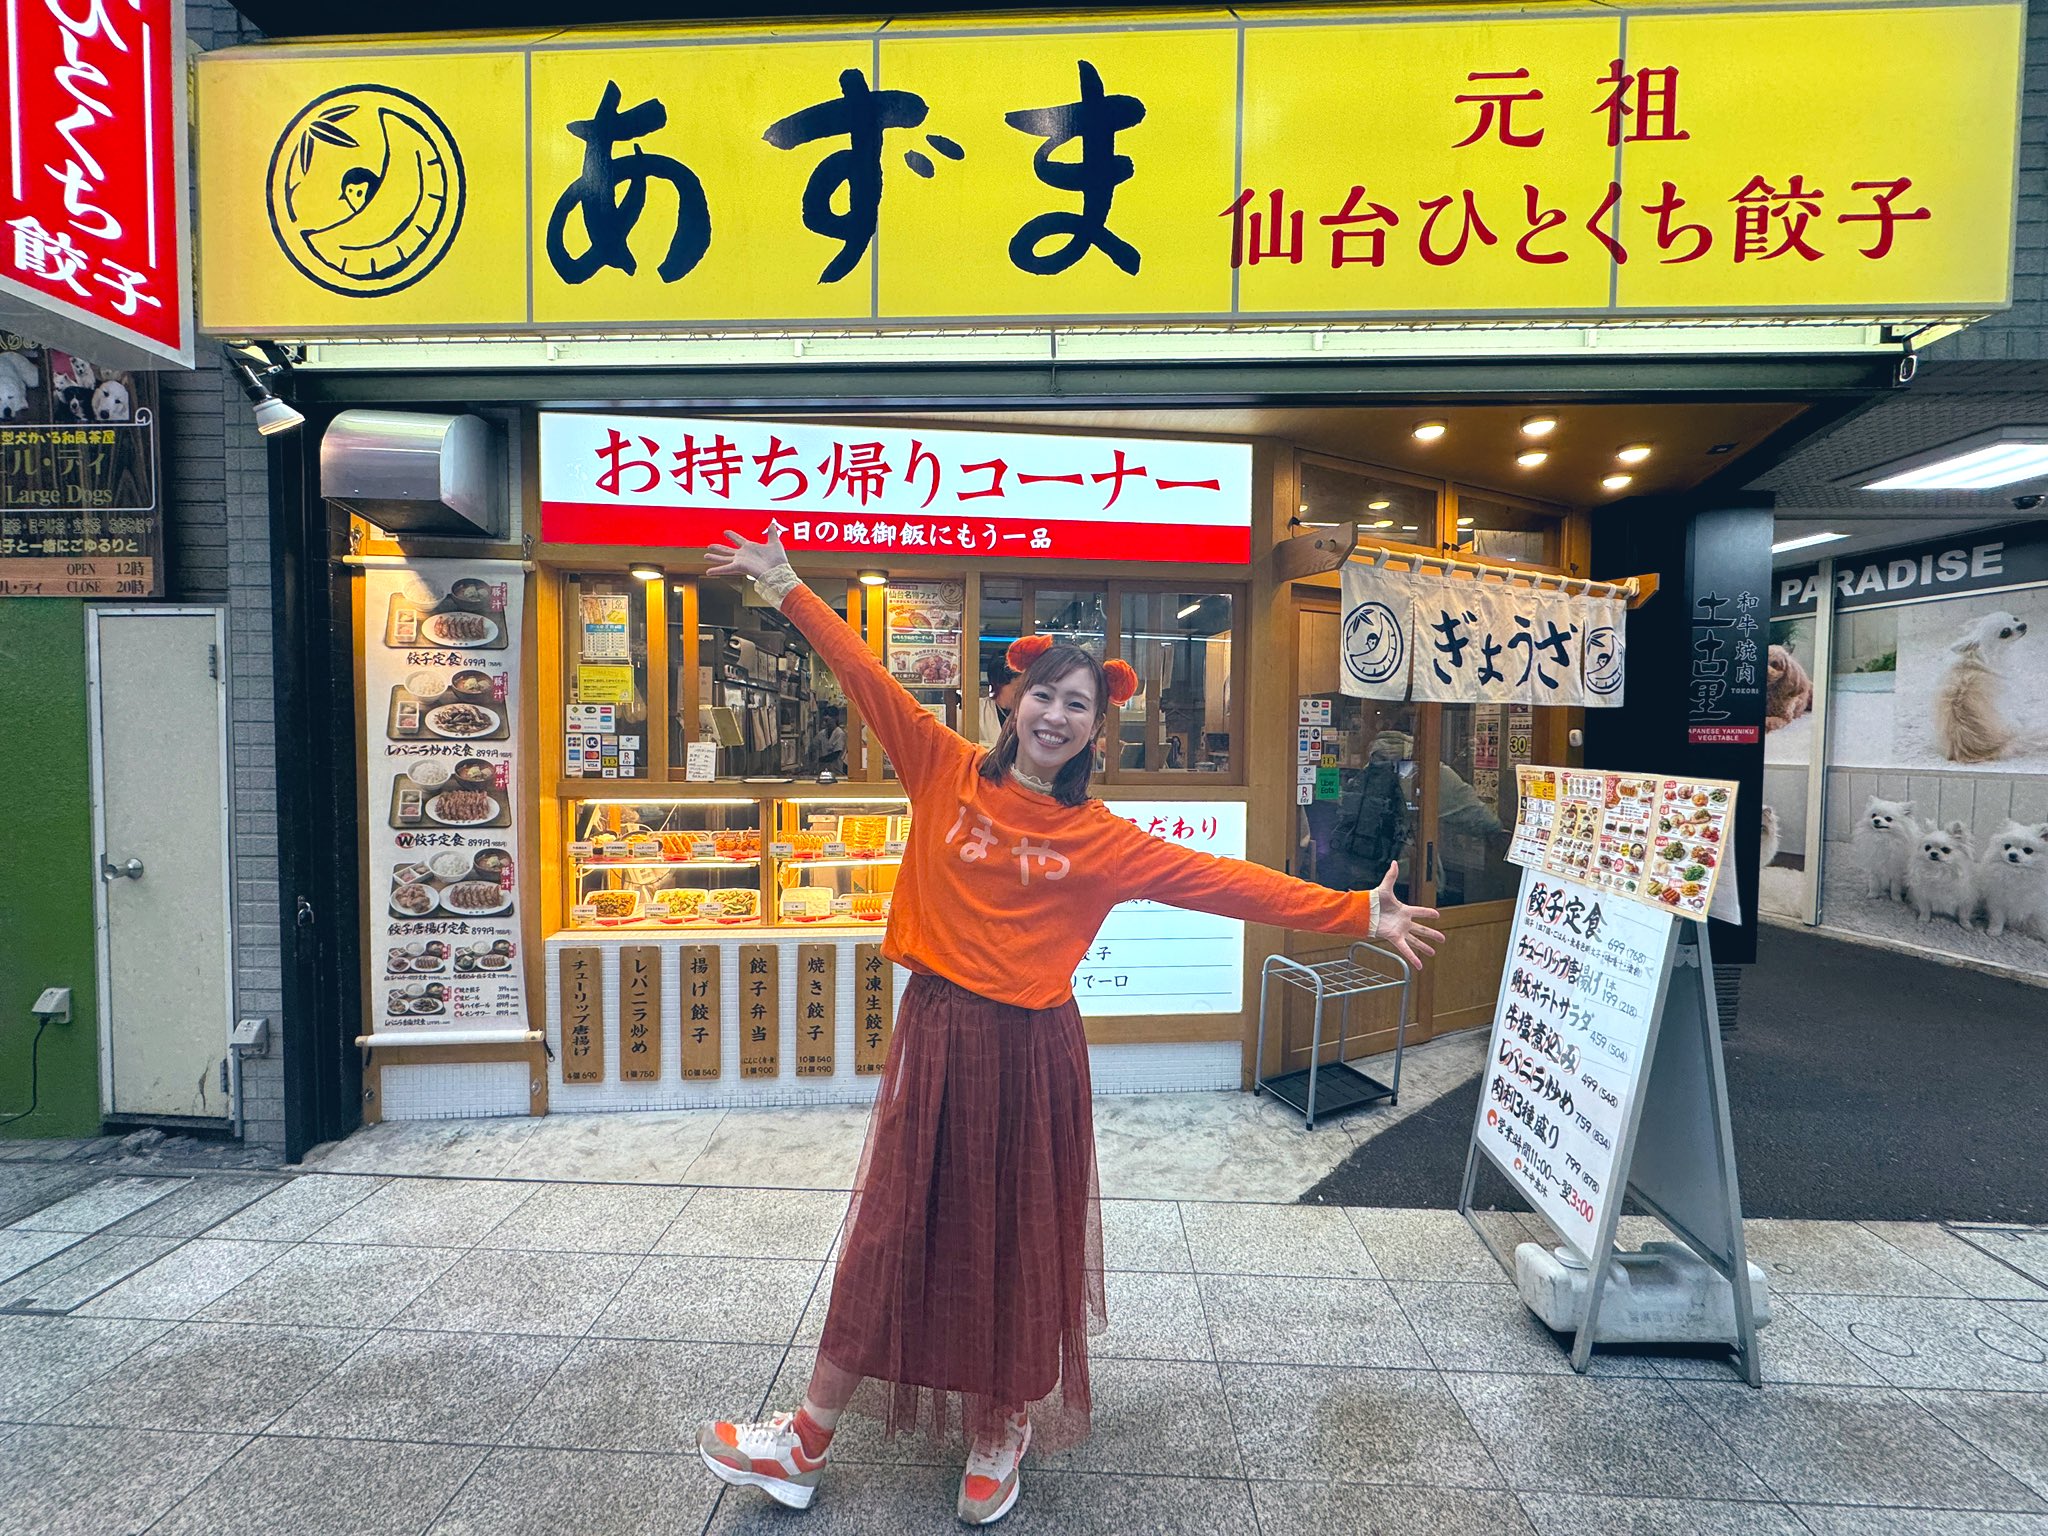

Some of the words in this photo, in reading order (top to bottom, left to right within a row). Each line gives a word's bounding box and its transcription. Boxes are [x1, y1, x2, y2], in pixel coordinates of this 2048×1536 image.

[44, 0, 129, 240] ひとくち
[1452, 59, 1691, 149] 元祖
[546, 60, 1147, 286] あずま
[1218, 175, 1932, 269] 仙台ひとくち餃子
[5, 215, 162, 317] 餃子
[0, 450, 106, 477] ル・ディ
[7, 484, 60, 506] Large
[67, 484, 113, 507] Dogs
[594, 427, 1222, 511] お持ち帰りコーナー
[0, 539, 138, 553] 子と一緒にごゆるりと
[66, 563, 96, 575] OPEN
[117, 562, 144, 576] 12時
[1780, 542, 2005, 607] PARADISE
[66, 581, 101, 593] CLOSE
[116, 581, 144, 594] 20時
[407, 651, 461, 666] 餃子定食
[463, 658, 486, 668] 699円
[1432, 609, 1578, 689] ぎょうざ
[1735, 591, 1760, 686] 和牛焼肉
[386, 744, 474, 757] レバニラ炒め定食
[476, 750, 498, 758] 899円
[1510, 736, 1528, 754] 30
[468, 839, 490, 847] 899円
[945, 806, 1071, 887] ほや
[388, 922, 470, 935] 餃子唐揚げ定食
[472, 927, 494, 935] 899円
[1528, 882, 1608, 942] 餃子定食
[1608, 938, 1625, 954] 699
[690, 957, 709, 1044] 揚げ餃子
[749, 958, 768, 1042] 餃子弁当
[807, 957, 825, 1041] 焼き餃子
[865, 956, 883, 1048] 冷凍生餃子
[1518, 934, 1604, 996] チューリップ唐揚げ
[571, 960, 590, 1056] チューリップ唐揚げ
[631, 959, 649, 1054] レバニラ炒め
[1505, 1002, 1580, 1074] 牛塩煮込み
[1580, 1072, 1599, 1092] 499
[1510, 968, 1596, 1032] 明太ポテトサラダ
[1590, 1030, 1608, 1050] 459
[1499, 1038, 1575, 1116] レバニラ炒め
[1575, 1111, 1592, 1134] 759
[1565, 1152, 1582, 1175] 799
